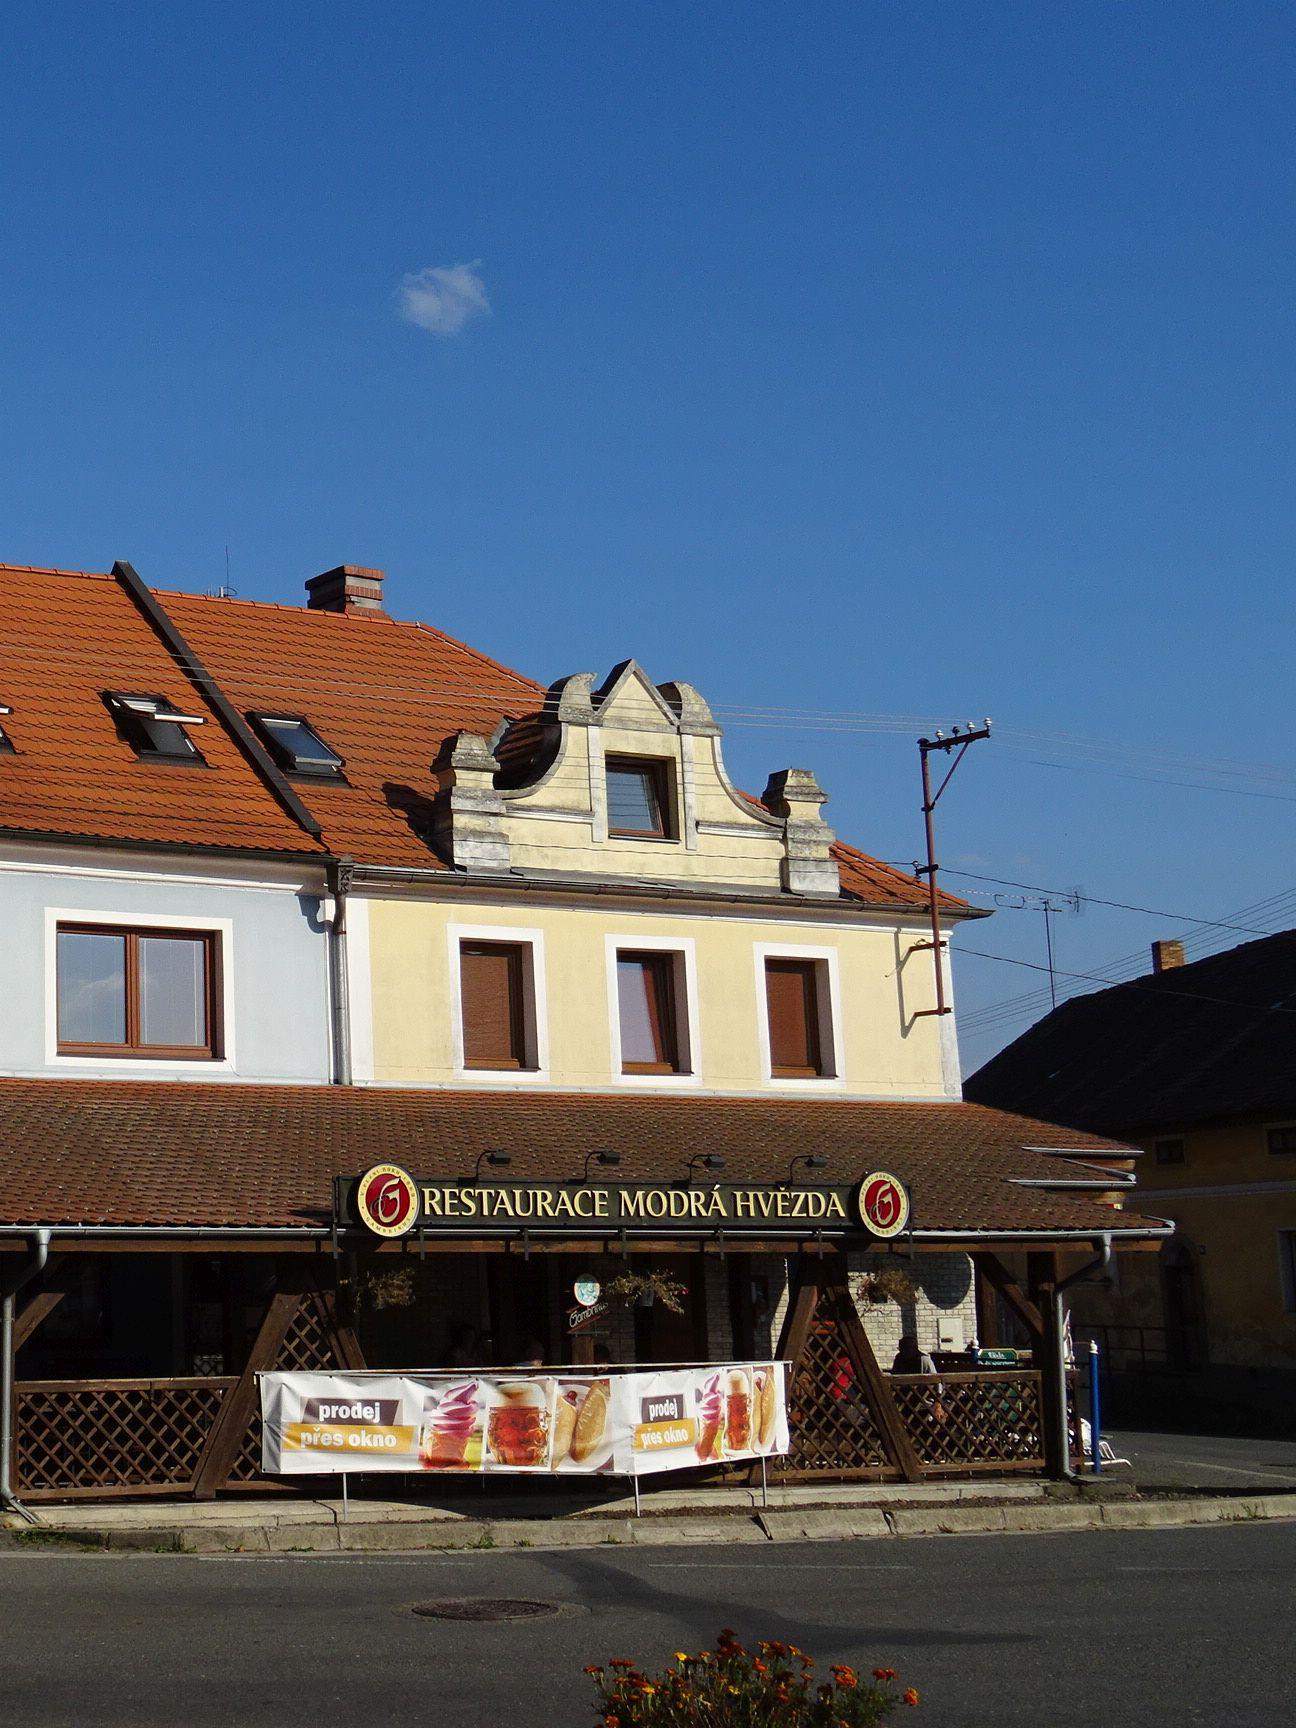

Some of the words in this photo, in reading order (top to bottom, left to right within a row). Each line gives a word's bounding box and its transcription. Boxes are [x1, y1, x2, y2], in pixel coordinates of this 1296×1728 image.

[421, 1188, 609, 1217] RESTAURACE
[618, 1184, 728, 1217] MODRÁ
[733, 1186, 846, 1218] HVĚZDA
[319, 1402, 381, 1423] prodej
[649, 1398, 678, 1421] prodej
[300, 1427, 344, 1448] přes
[349, 1430, 397, 1447] okno
[641, 1428, 663, 1449] přes
[664, 1426, 689, 1443] okno
